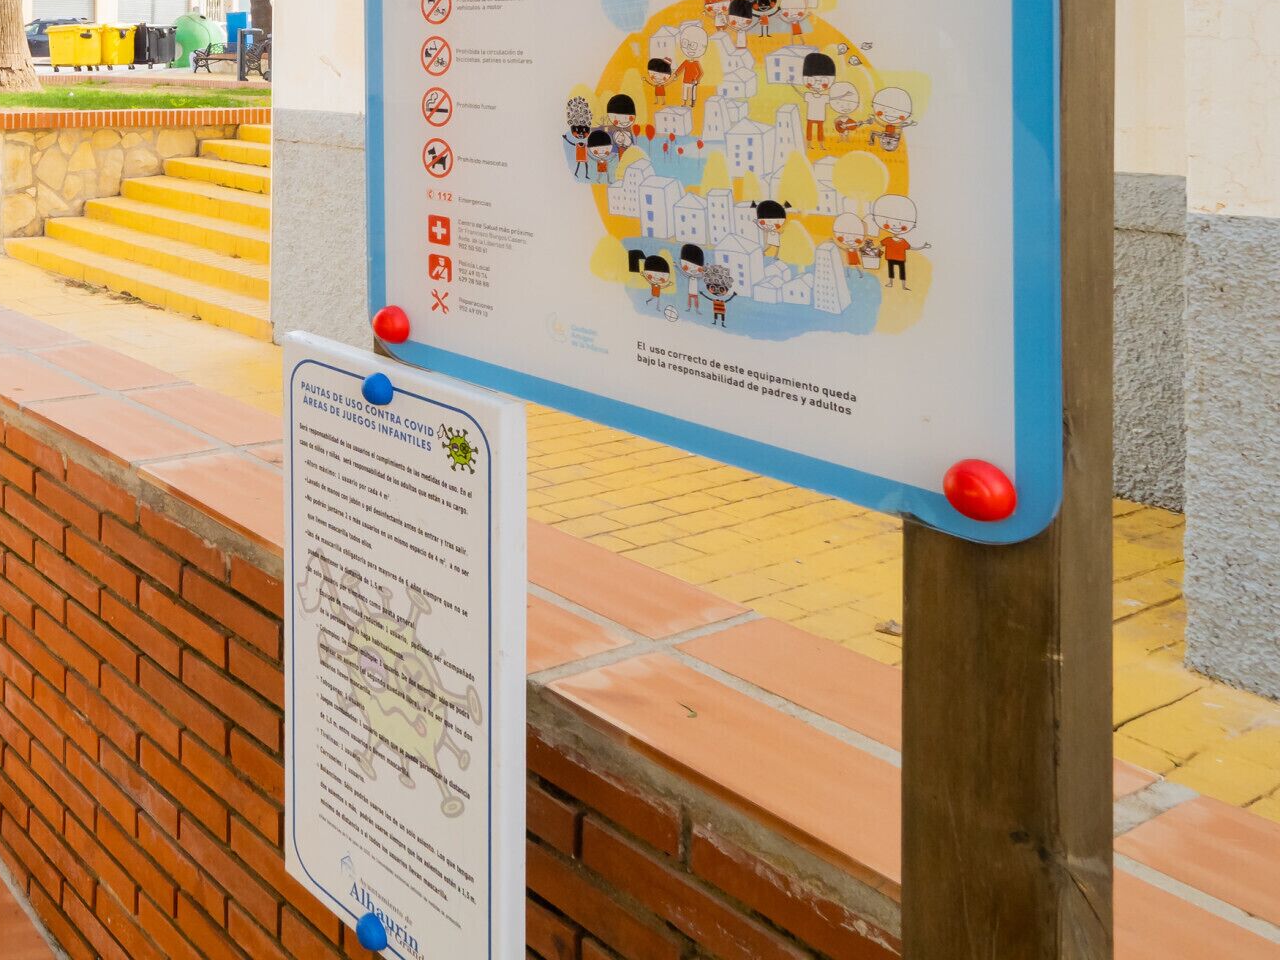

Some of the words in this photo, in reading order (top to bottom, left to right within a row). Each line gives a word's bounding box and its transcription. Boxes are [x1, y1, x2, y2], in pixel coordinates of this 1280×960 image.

[437, 192, 452, 201] 112
[637, 341, 646, 351] El
[649, 344, 666, 355] uso
[667, 348, 708, 366] correcto
[709, 358, 721, 369] de
[723, 362, 745, 375] este
[747, 367, 820, 393] equipamiento
[822, 386, 857, 403] queda
[637, 354, 656, 367] bajo
[657, 358, 666, 368] la
[667, 362, 745, 388] responsabilidad
[747, 380, 759, 392] de
[761, 384, 798, 402] padres
[800, 395, 808, 406] y
[808, 396, 852, 415] adultos
[301, 381, 330, 399] PAUTAS
[332, 392, 343, 403] DE
[345, 397, 362, 411] USO
[364, 403, 401, 425] CONTRA
[404, 418, 433, 437] COVID
[302, 392, 327, 411] ÁREAS
[329, 405, 339, 416] DE
[341, 409, 375, 430] JUEGOS
[378, 423, 431, 451] INFANTILES
[308, 426, 338, 444] responsabilidad
[352, 443, 370, 456] usuarios
[376, 453, 405, 471] cumplimiento
[412, 468, 420, 477] las
[420, 471, 440, 485] medidas
[440, 479, 447, 488] de
[448, 483, 458, 493] uso.
[459, 487, 466, 496] En
[467, 489, 472, 498] el
[341, 474, 357, 487] usuario
[358, 482, 366, 491] por
[367, 485, 378, 496] cada
[352, 459, 385, 480] responsabilidad
[386, 474, 391, 482] de
[400, 480, 416, 492] adultos
[417, 488, 426, 498] que
[452, 503, 468, 516] cargo.
[340, 492, 348, 501] con
[373, 506, 403, 526] desinfectante
[403, 521, 416, 532] antes
[417, 526, 423, 535] de
[424, 530, 439, 543] entrar
[444, 539, 454, 550] tras
[341, 813, 359, 832] distancia
[392, 816, 397, 826] de
[399, 822, 405, 831] un
[436, 849, 445, 862] Los
[446, 857, 455, 870] que
[456, 864, 474, 885] tengan
[406, 846, 415, 858] que
[423, 859, 442, 878] asientos
[350, 882, 419, 953] Alhaurín
[360, 878, 403, 919] Ayuntamiento
